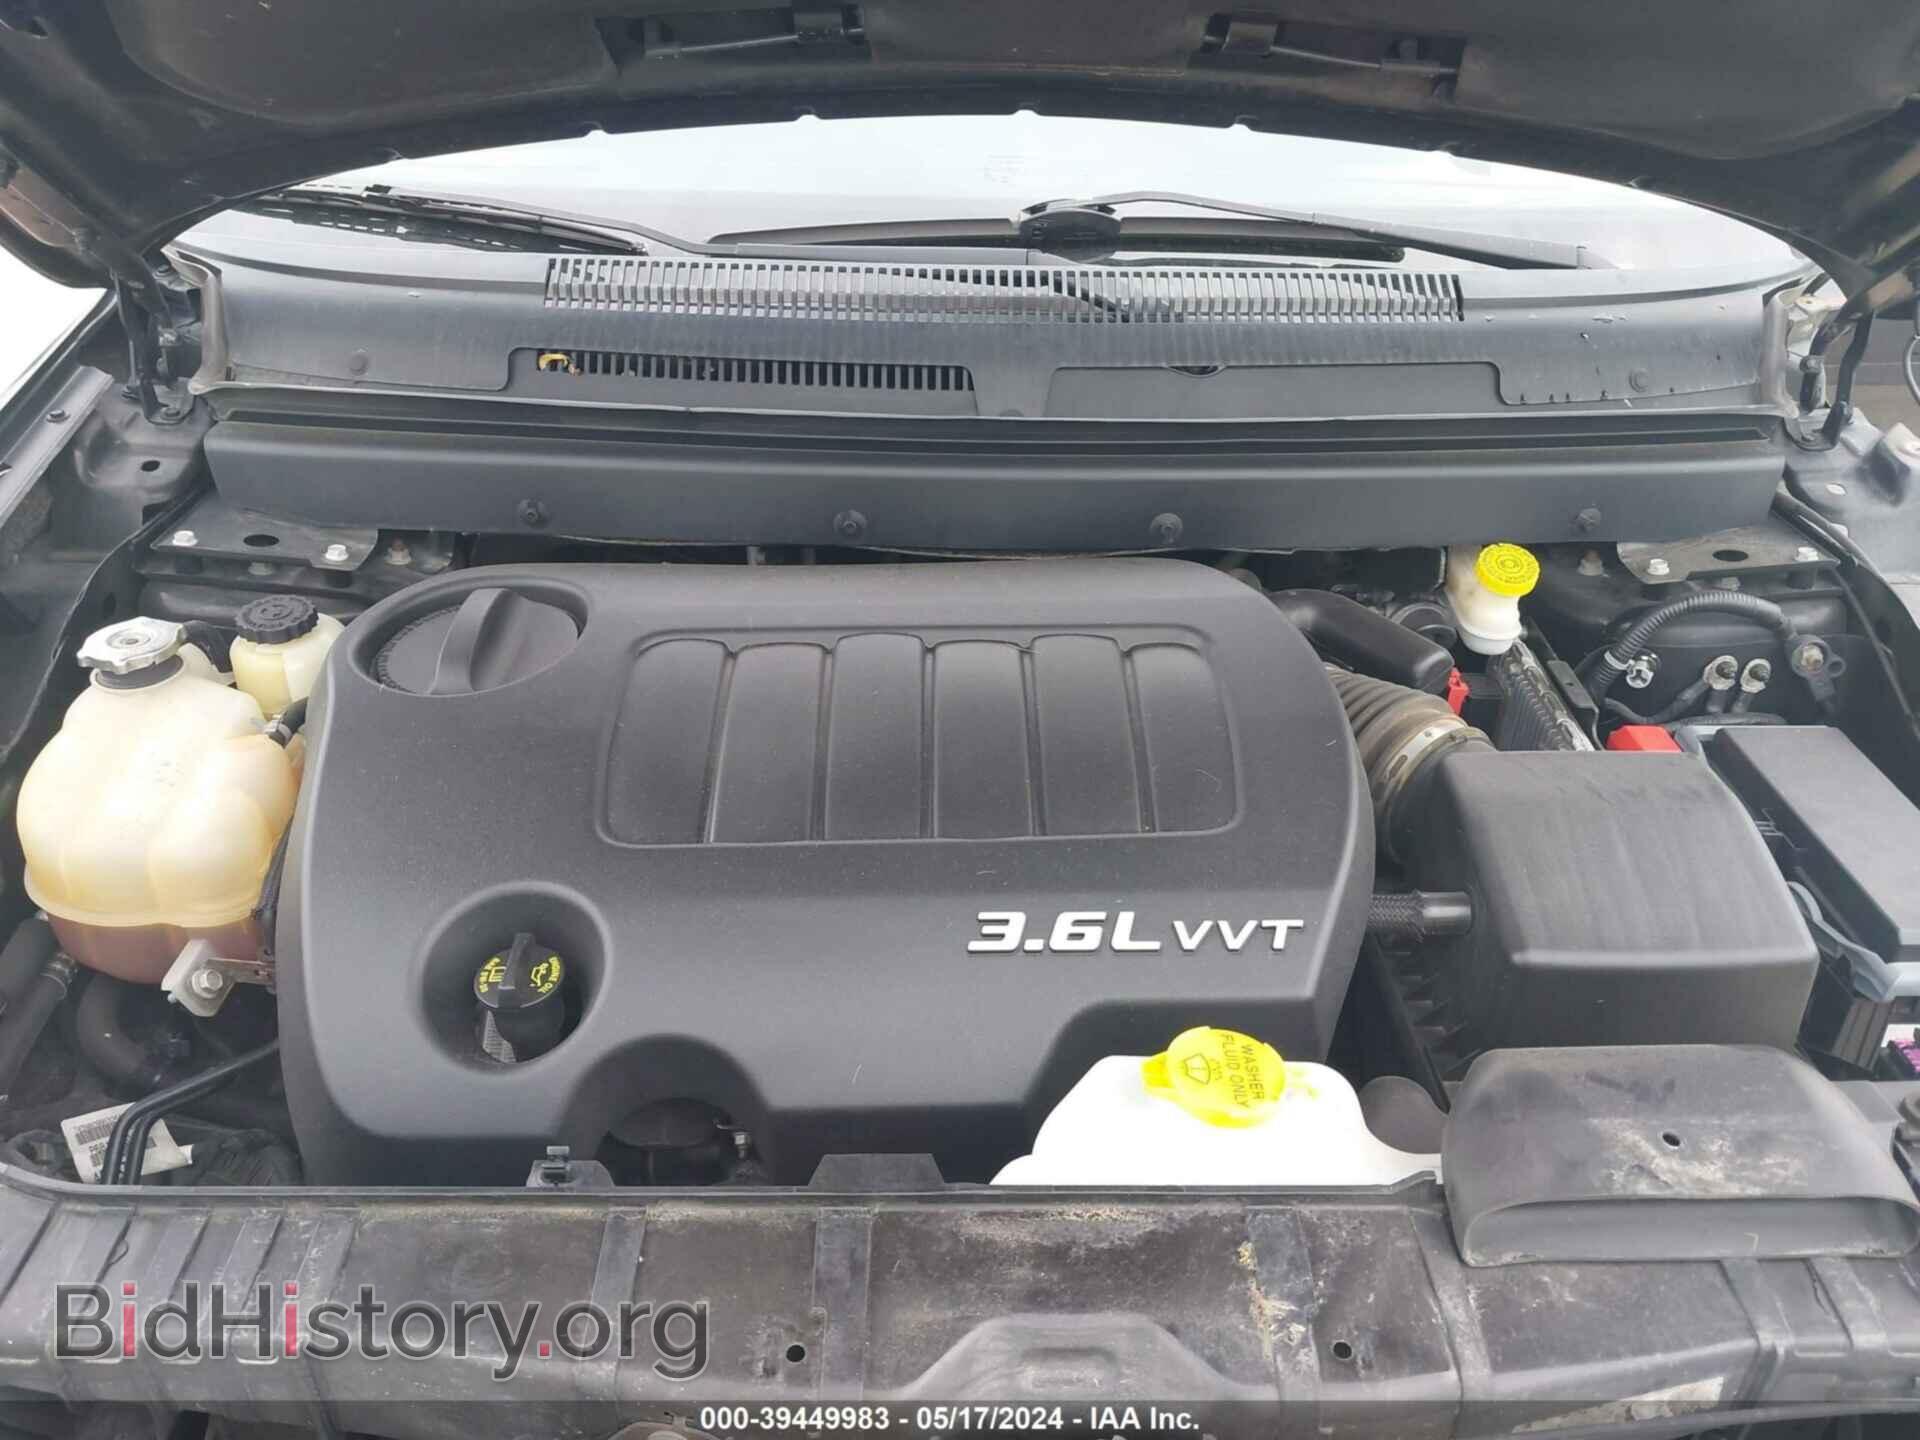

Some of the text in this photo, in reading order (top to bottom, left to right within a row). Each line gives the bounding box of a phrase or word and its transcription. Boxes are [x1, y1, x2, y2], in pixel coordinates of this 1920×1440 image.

[967, 911, 1304, 952] 3.6L VVT
[1221, 1034, 1249, 1108] FLUID ONLY
[1241, 1044, 1264, 1100] WASHER
